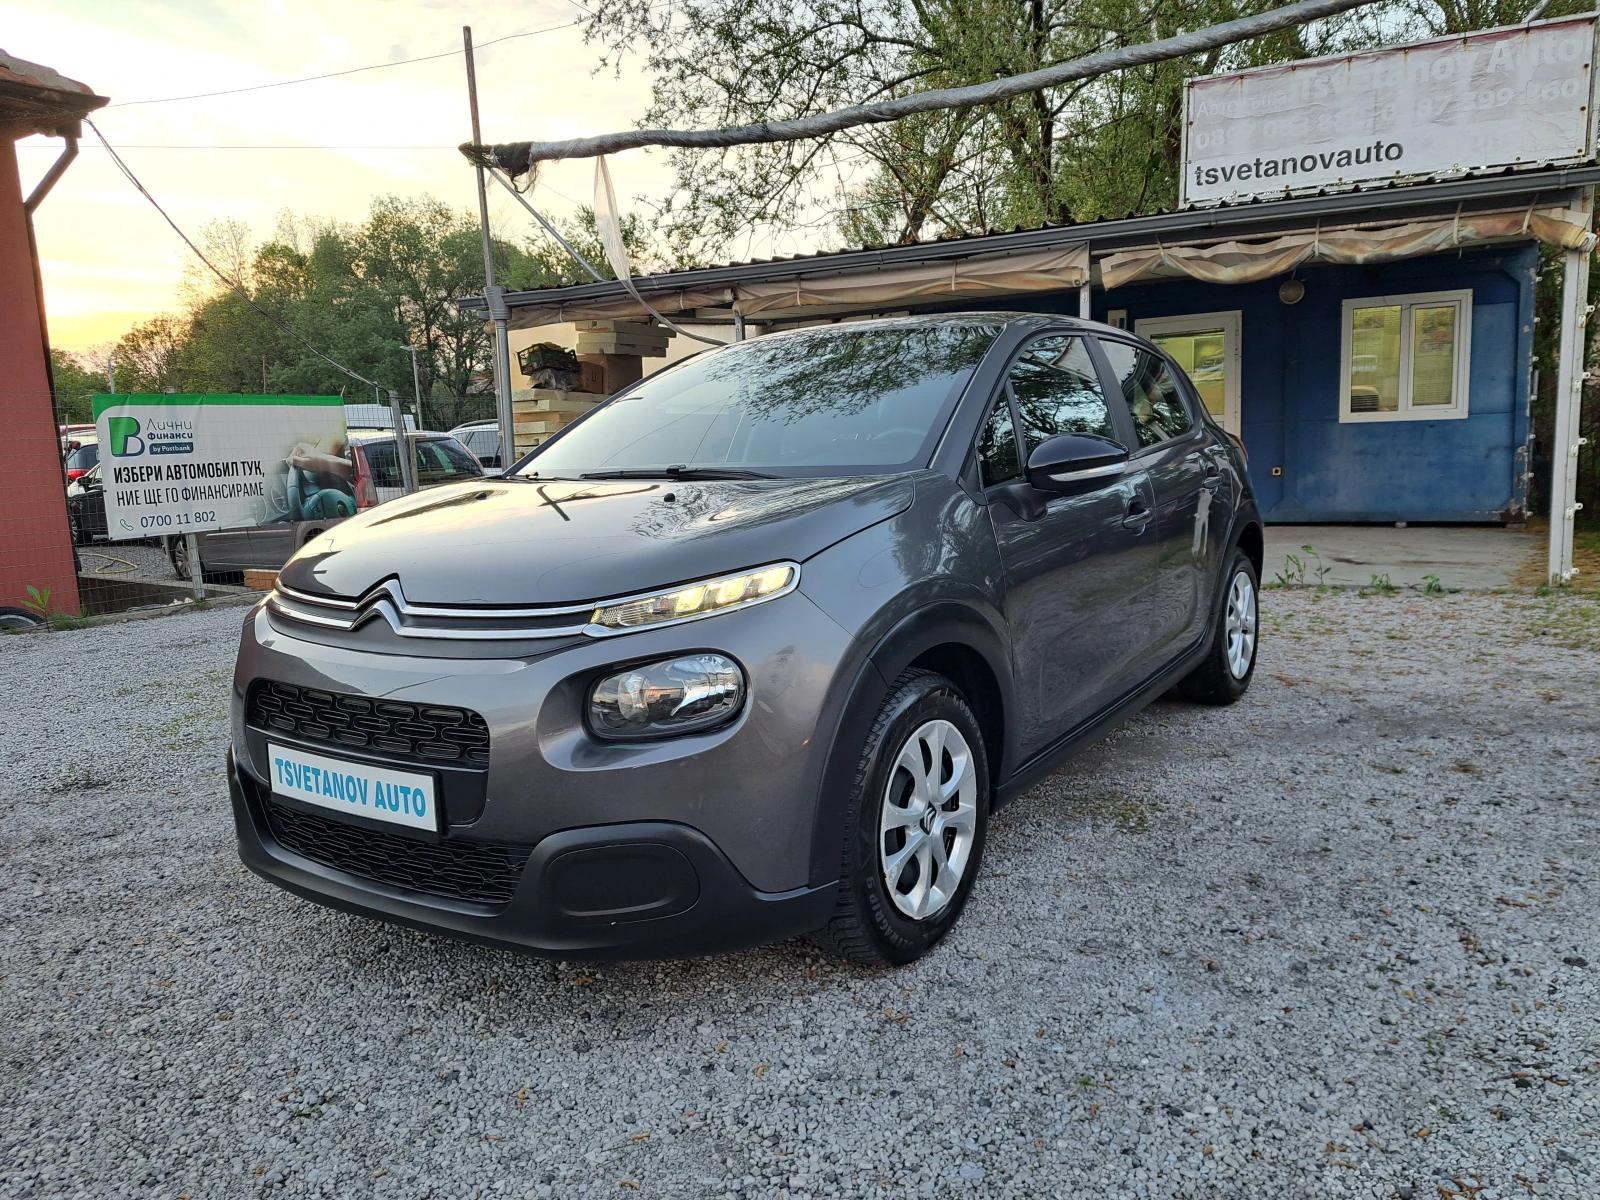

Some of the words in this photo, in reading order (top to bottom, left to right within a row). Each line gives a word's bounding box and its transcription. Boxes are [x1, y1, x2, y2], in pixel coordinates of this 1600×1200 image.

[1196, 93, 1288, 118] Автоъща
[1194, 139, 1404, 187] tsvetanovauto
[146, 418, 193, 431] Лични
[147, 432, 194, 441] Финанси
[113, 465, 163, 484] ИЗБЕРИ
[166, 461, 240, 481] АВТОМОБИЛ
[240, 460, 265, 478] ТУК,
[116, 489, 142, 507] НИЕ
[143, 488, 164, 507] ЩЕ
[165, 487, 179, 503] ГО
[181, 482, 265, 502] ФИНАНСИРАМЕ
[140, 514, 172, 528] 0700
[175, 513, 190, 525] 11
[194, 510, 216, 523] 802
[274, 757, 369, 806] TSVETANOV
[374, 780, 427, 818] AUTO
